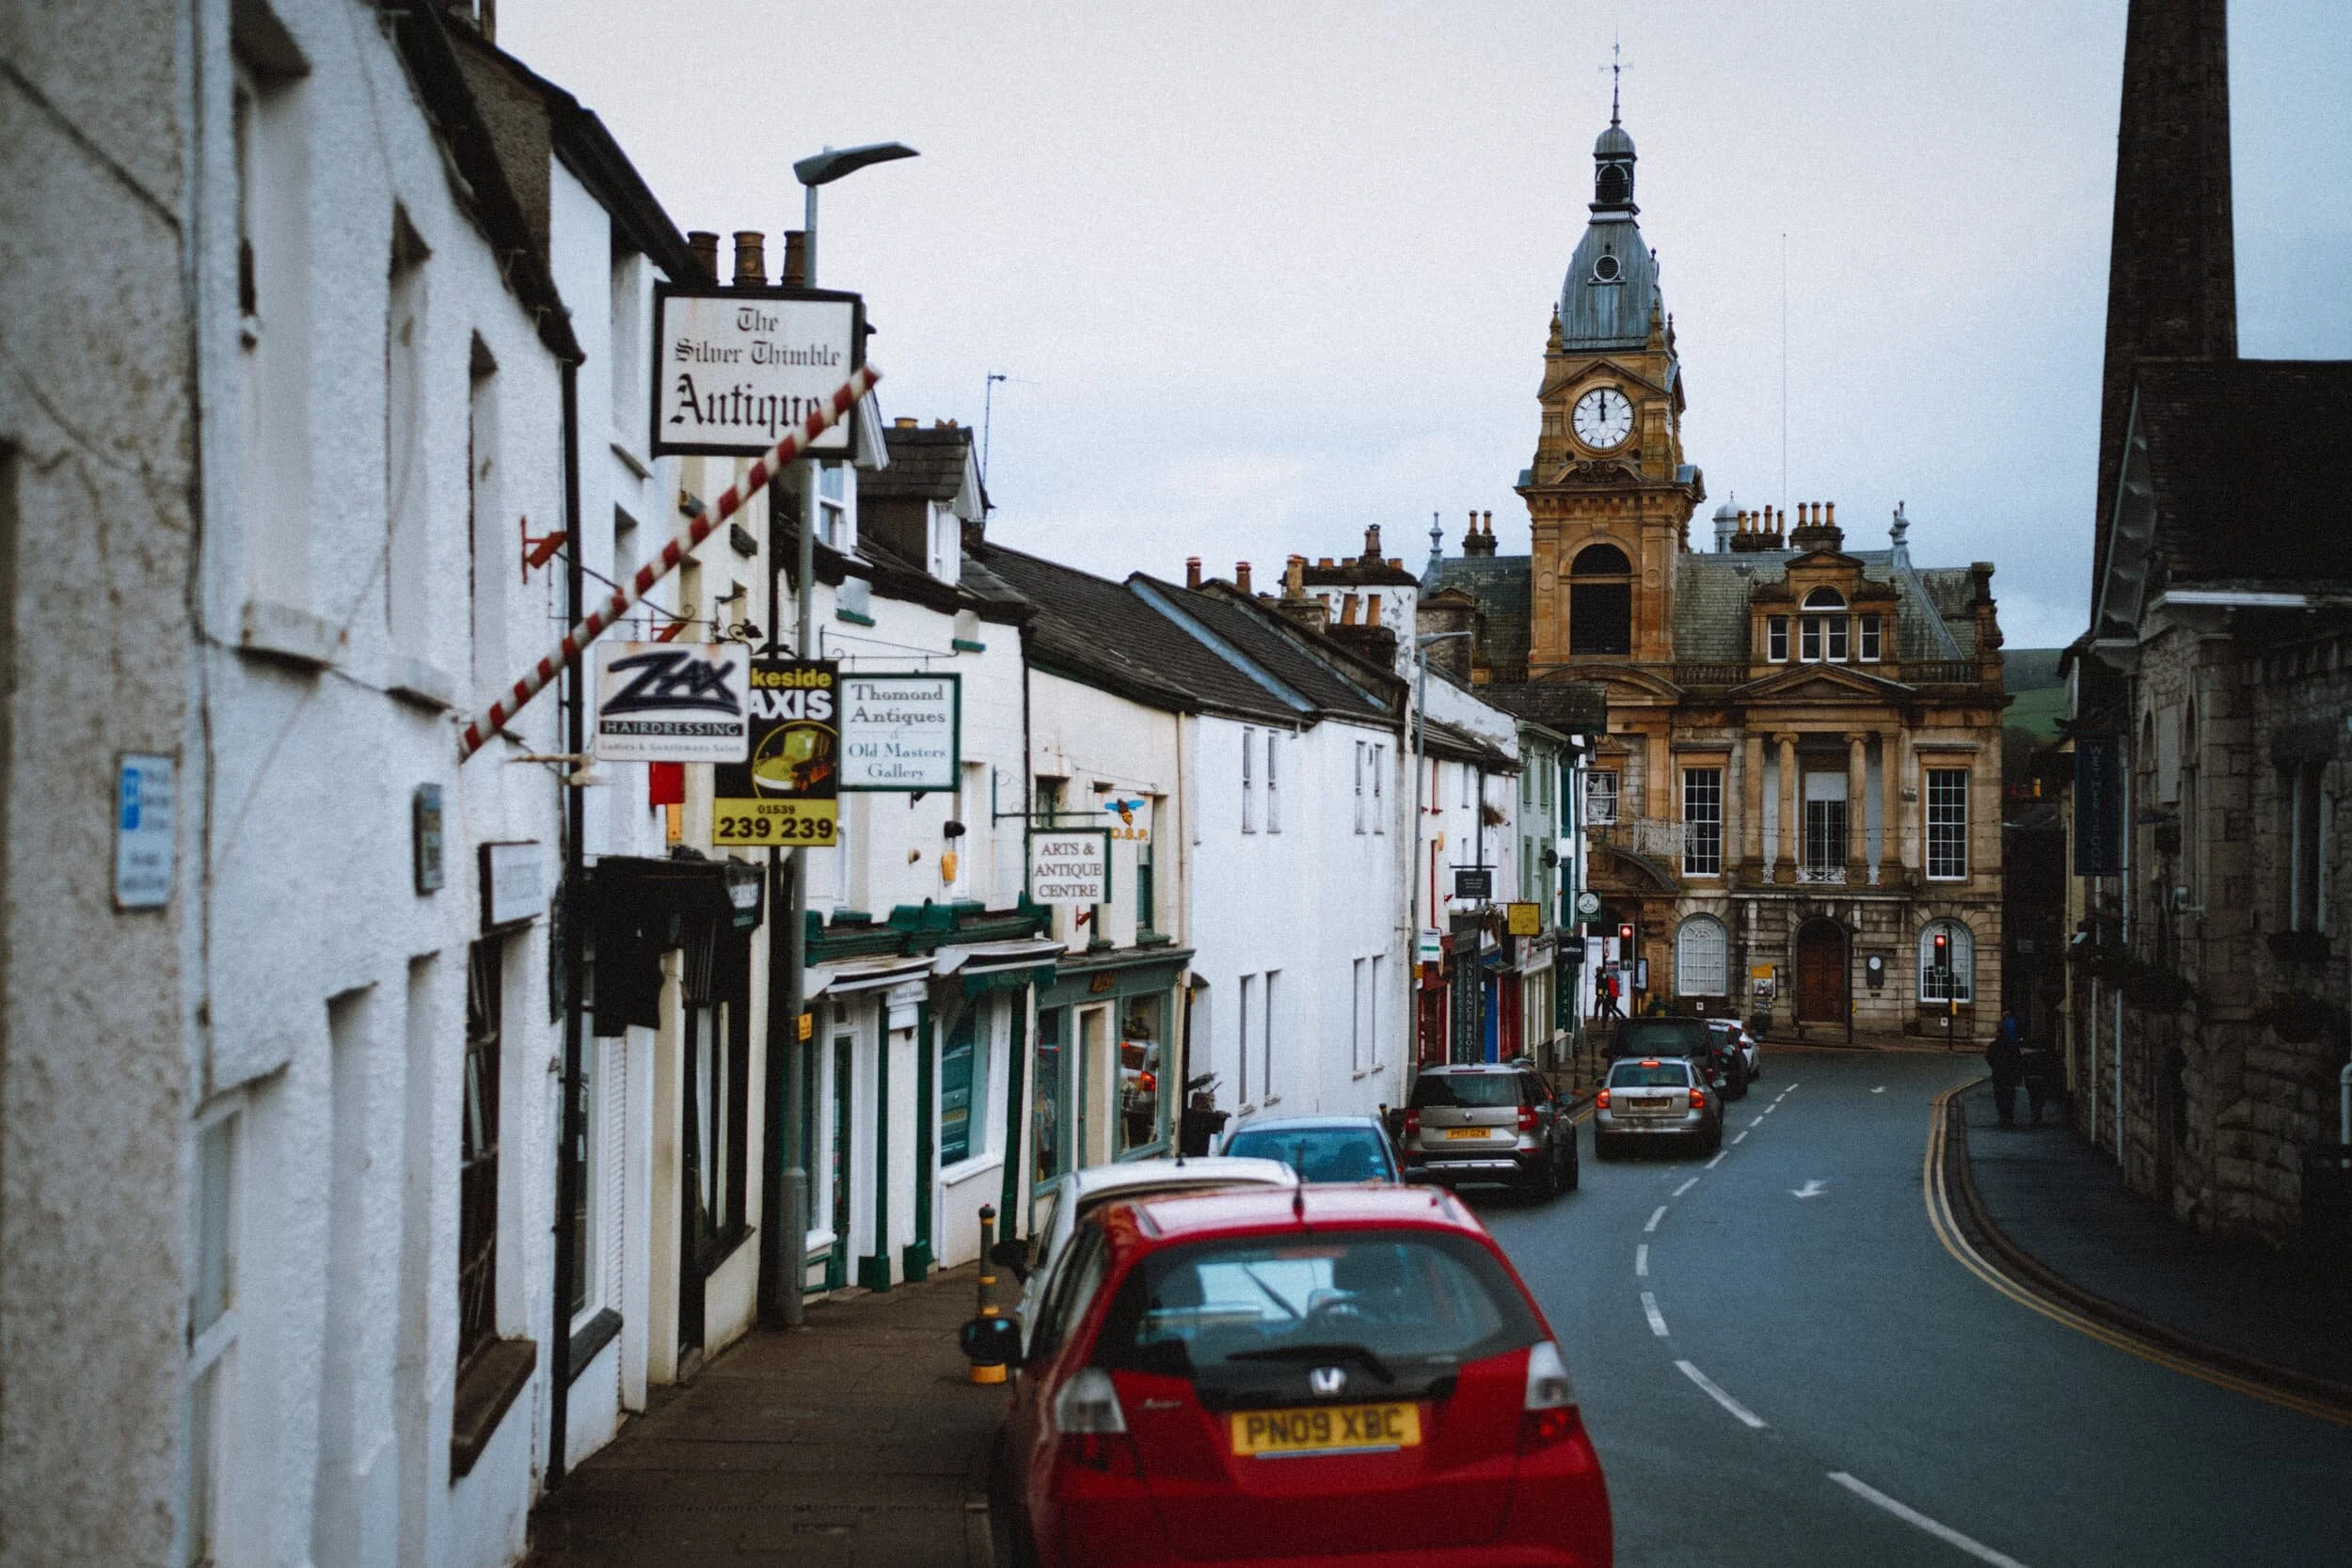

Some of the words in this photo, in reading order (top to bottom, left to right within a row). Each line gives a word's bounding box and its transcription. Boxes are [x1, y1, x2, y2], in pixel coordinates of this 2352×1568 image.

[737, 308, 779, 331] The
[675, 339, 742, 364] Silver
[752, 341, 841, 366] Thimble
[670, 373, 840, 438] Antique
[751, 668, 832, 688] keside
[850, 684, 944, 701] Thomond
[750, 689, 833, 721] AXIS
[850, 706, 946, 725] Antiques
[605, 723, 739, 735] HAIRDRESSING
[849, 742, 877, 757] Old
[884, 743, 946, 758] Masters
[867, 763, 925, 780] Gallery
[757, 805, 795, 815] 01539
[720, 817, 771, 837] 239
[782, 817, 833, 838] 239
[1041, 843, 1079, 855] ARTS
[1083, 843, 1095, 855] &
[1034, 863, 1102, 878] ANTIQUE
[1039, 884, 1099, 897] CENTRE
[1247, 1412, 1332, 1445] PN09
[1343, 1407, 1403, 1440] XBC
